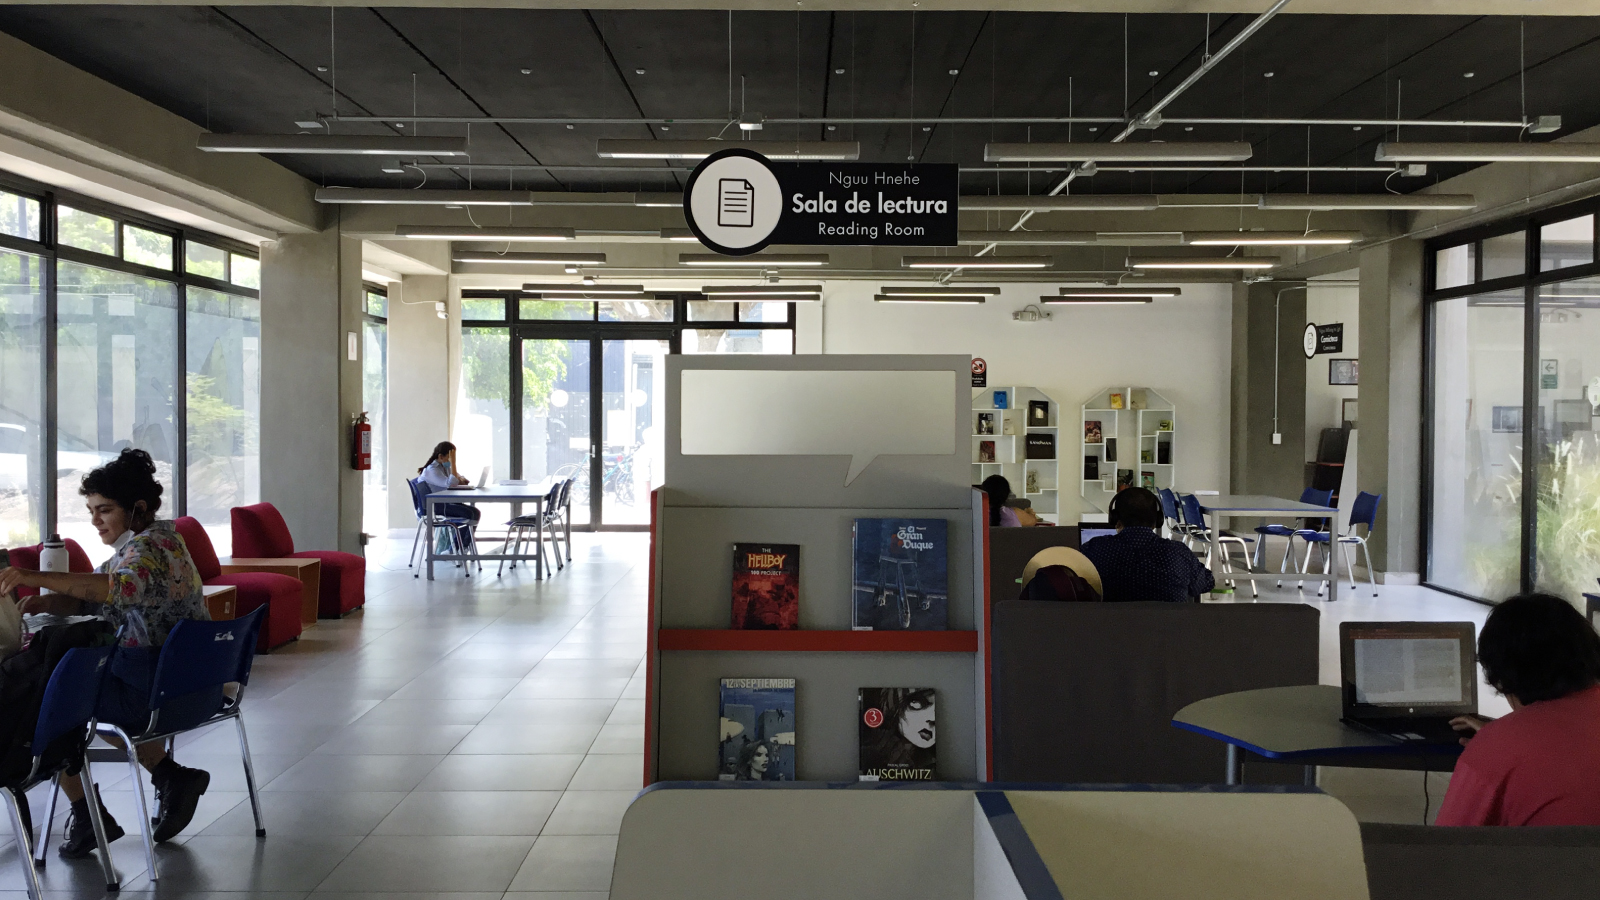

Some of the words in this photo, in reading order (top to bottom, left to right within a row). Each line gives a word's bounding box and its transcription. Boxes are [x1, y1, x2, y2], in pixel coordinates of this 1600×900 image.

[829, 171, 868, 188] Nguu
[874, 171, 920, 185] Hnehe
[792, 191, 837, 214] Sala
[844, 191, 871, 214] de
[878, 191, 948, 214] lectura
[818, 221, 878, 239] Reading
[885, 223, 925, 236] Room
[897, 530, 923, 540] Gran
[902, 540, 934, 551] Duque
[747, 553, 786, 569] HELLBOY
[740, 679, 795, 688] SEPTIEMBRE
